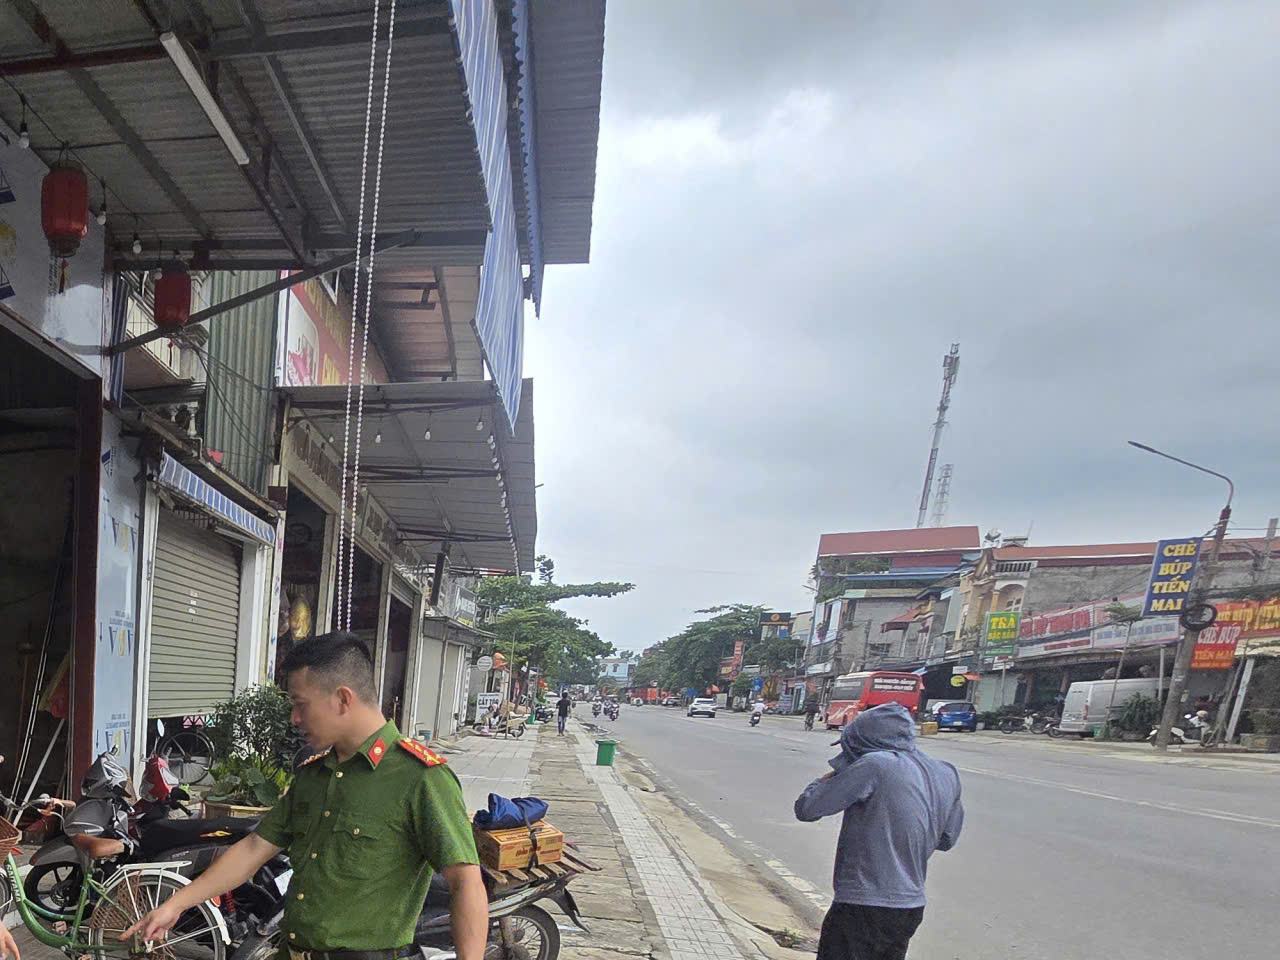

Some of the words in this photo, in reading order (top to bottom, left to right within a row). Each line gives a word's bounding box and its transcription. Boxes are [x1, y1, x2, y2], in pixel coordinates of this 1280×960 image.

[1163, 540, 1197, 557] CHÈ
[1157, 559, 1193, 576] BÚP
[1150, 597, 1184, 612] MAI
